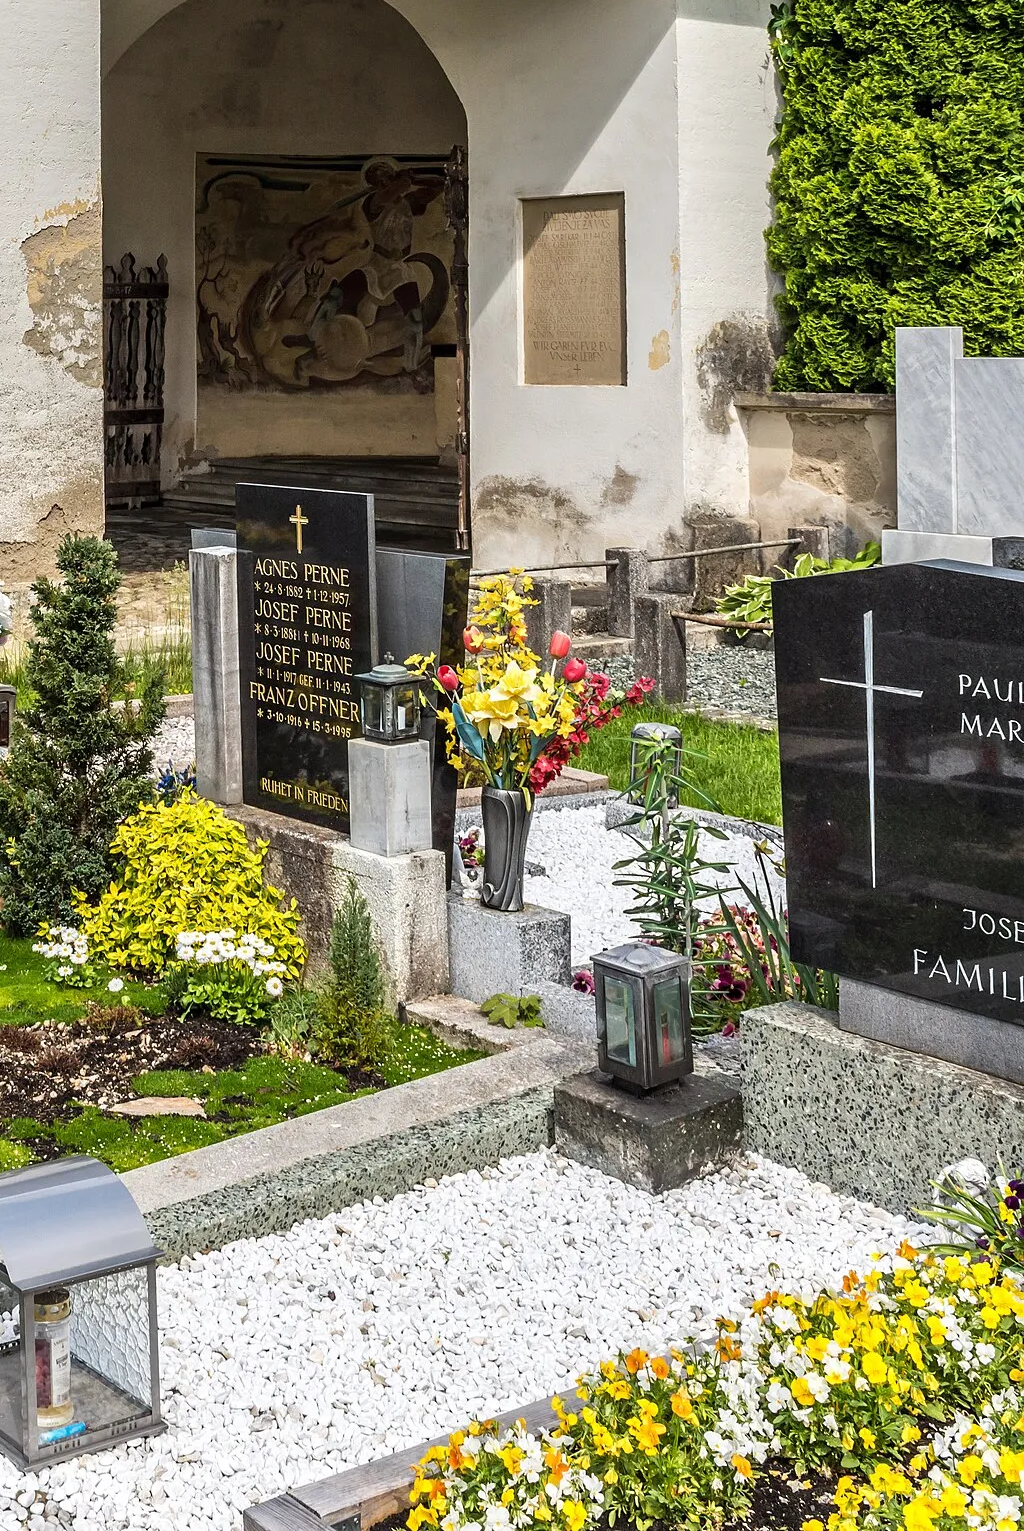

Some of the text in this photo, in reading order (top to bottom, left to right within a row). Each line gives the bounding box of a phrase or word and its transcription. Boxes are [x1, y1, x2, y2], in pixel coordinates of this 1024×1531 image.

[533, 340, 549, 351] WIR
[254, 557, 351, 588] AGNES PERNE
[255, 598, 352, 631] JOSEF PERNE
[256, 641, 353, 676] JOSEF PERNE
[249, 681, 360, 723] FRANZ OFFNER
[261, 777, 349, 813] RUHET IN FRIEDEN
